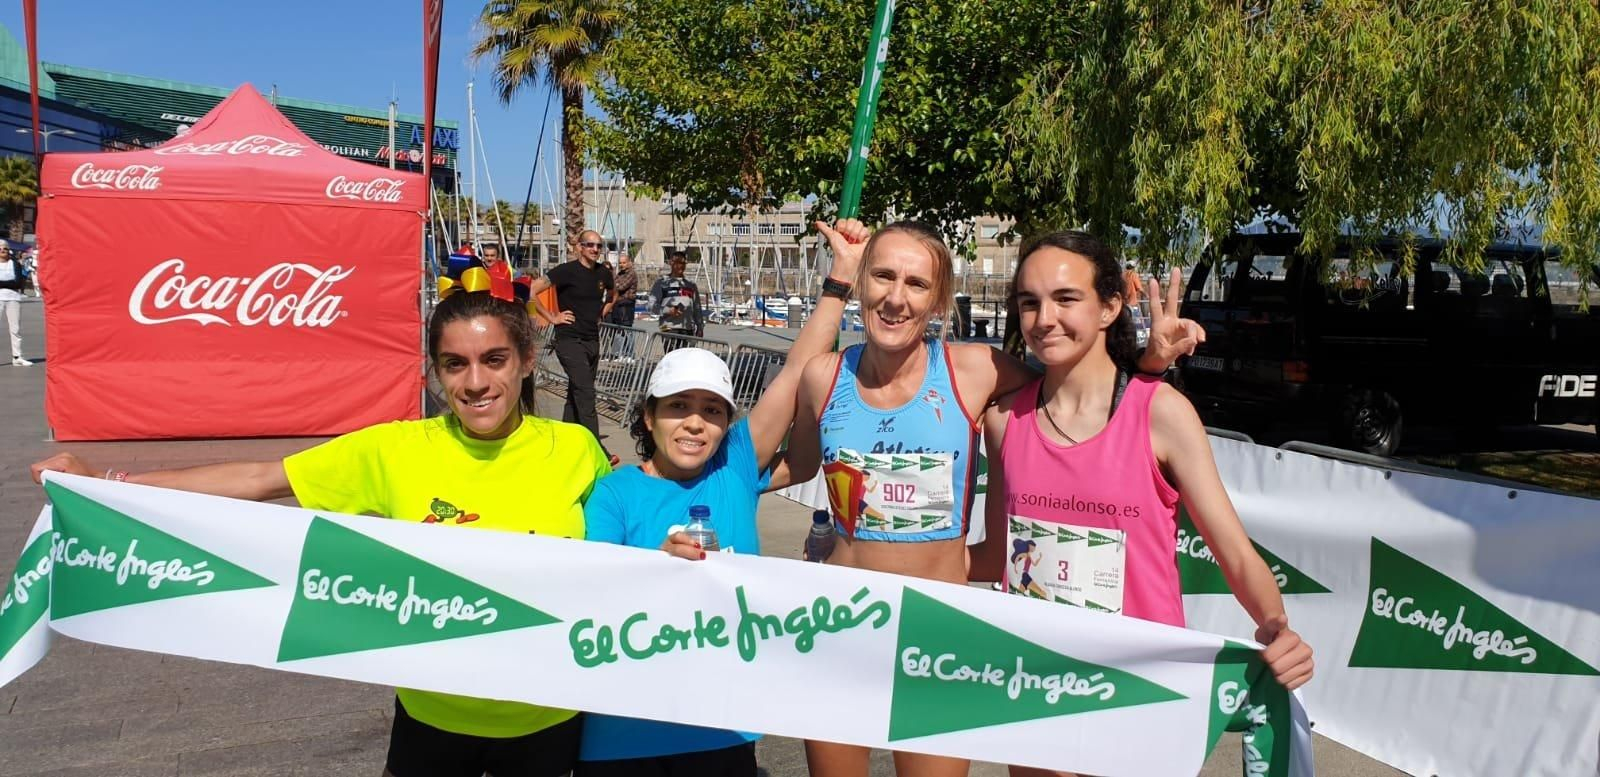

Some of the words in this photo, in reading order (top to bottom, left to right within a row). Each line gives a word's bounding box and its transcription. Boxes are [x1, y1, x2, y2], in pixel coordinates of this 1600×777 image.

[154, 135, 307, 157] Coca-Cola
[320, 144, 369, 157] POLITAN
[71, 162, 164, 190] Coca-Cola
[325, 175, 406, 202] Coca-Cola
[128, 258, 357, 328] Coca-Cola
[883, 483, 916, 503] 902
[436, 506, 455, 515] 20:30
[65, 538, 117, 572] Corte
[116, 539, 215, 589] Inglés
[1057, 560, 1069, 582] 3
[302, 568, 331, 600] El
[332, 575, 398, 612] Corte
[398, 576, 498, 629] Inglés
[569, 618, 618, 668] El
[619, 611, 729, 660] Corte
[735, 585, 891, 662] Inglés
[1371, 587, 1394, 618] El
[1394, 597, 1448, 636] Corte
[1443, 606, 1537, 665] Inglés
[901, 646, 932, 677] El
[933, 653, 1005, 687] Corte
[1007, 656, 1116, 704] Inglés
